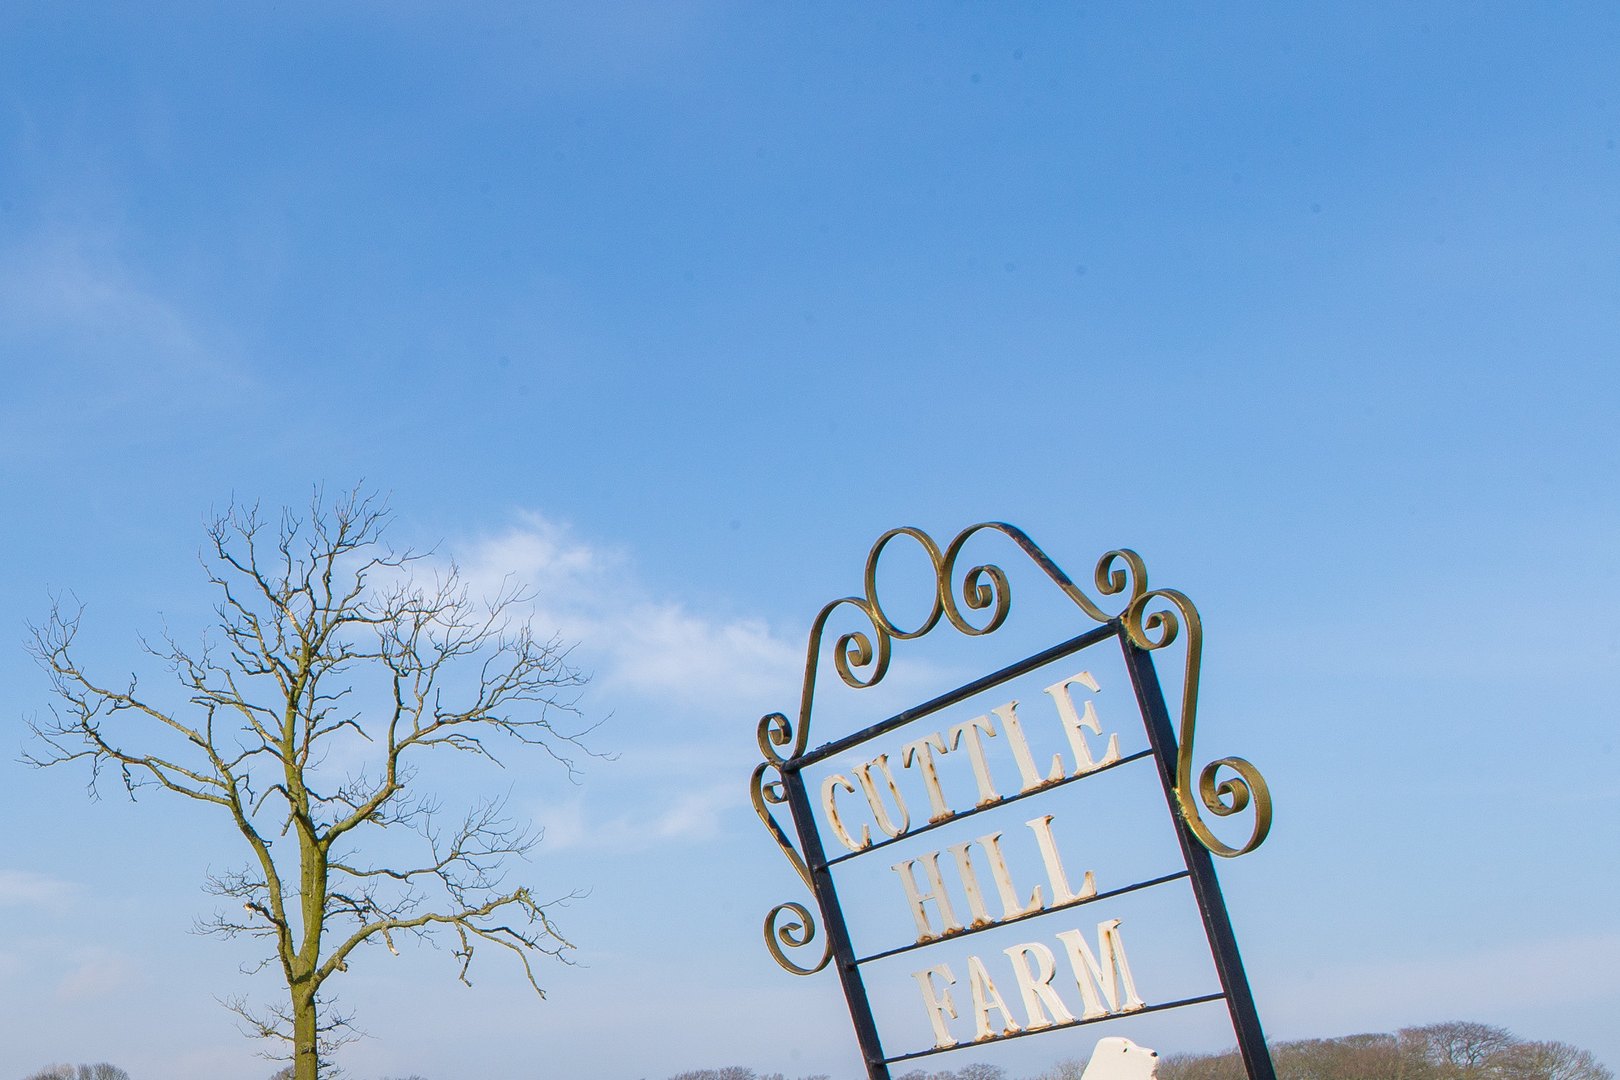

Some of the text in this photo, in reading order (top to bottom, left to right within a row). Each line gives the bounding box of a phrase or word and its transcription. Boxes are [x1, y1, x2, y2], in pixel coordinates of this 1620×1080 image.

[823, 672, 1120, 851] CUTTLE
[892, 815, 1095, 943] HILL
[913, 919, 1146, 1048] FARM
